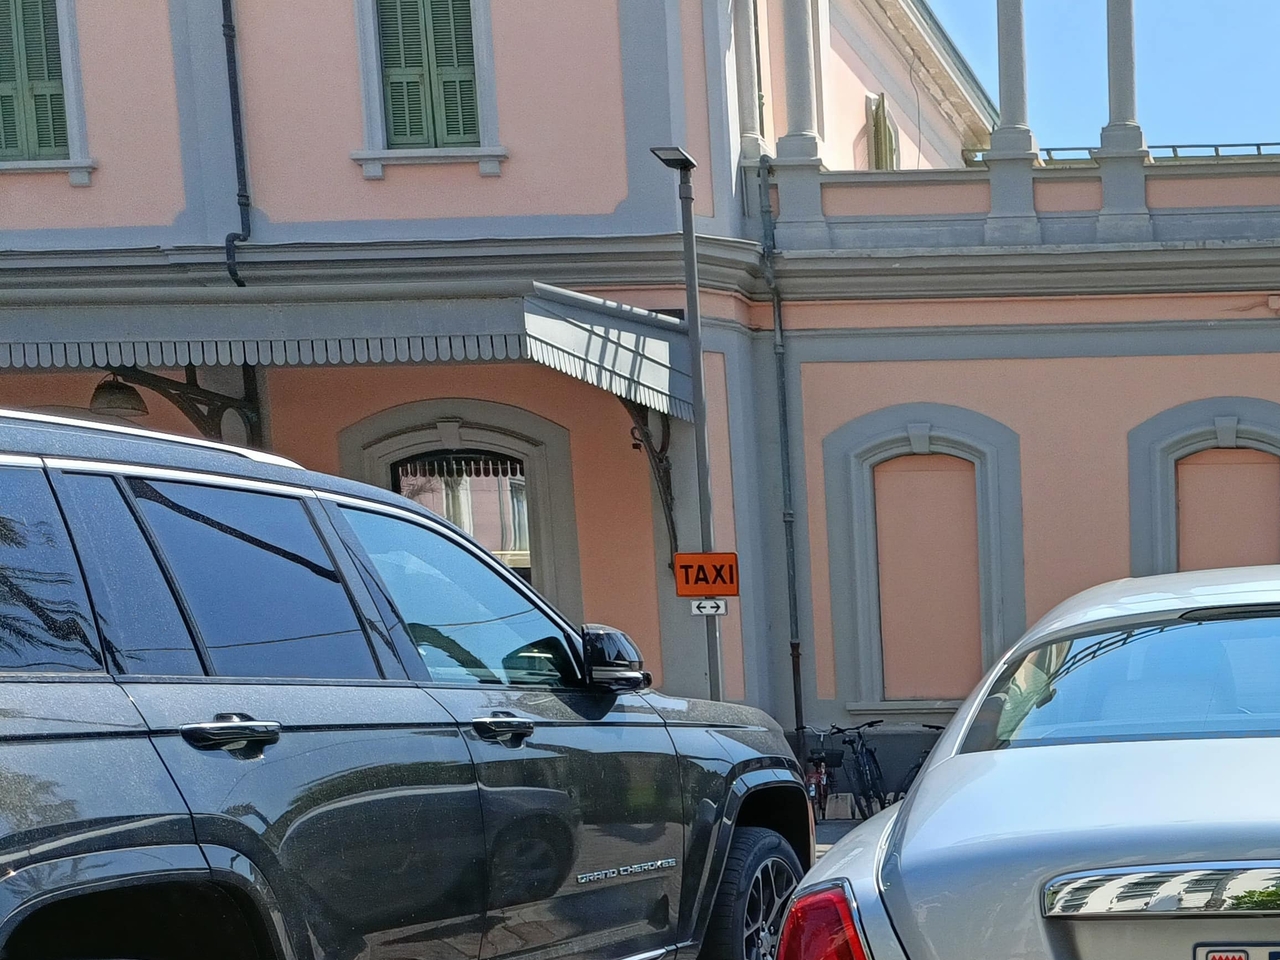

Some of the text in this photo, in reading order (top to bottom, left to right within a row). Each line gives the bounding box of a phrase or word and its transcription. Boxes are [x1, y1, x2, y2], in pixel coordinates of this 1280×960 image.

[680, 564, 734, 585] TAXI
[577, 858, 677, 883] GRAND CHEROKEE
